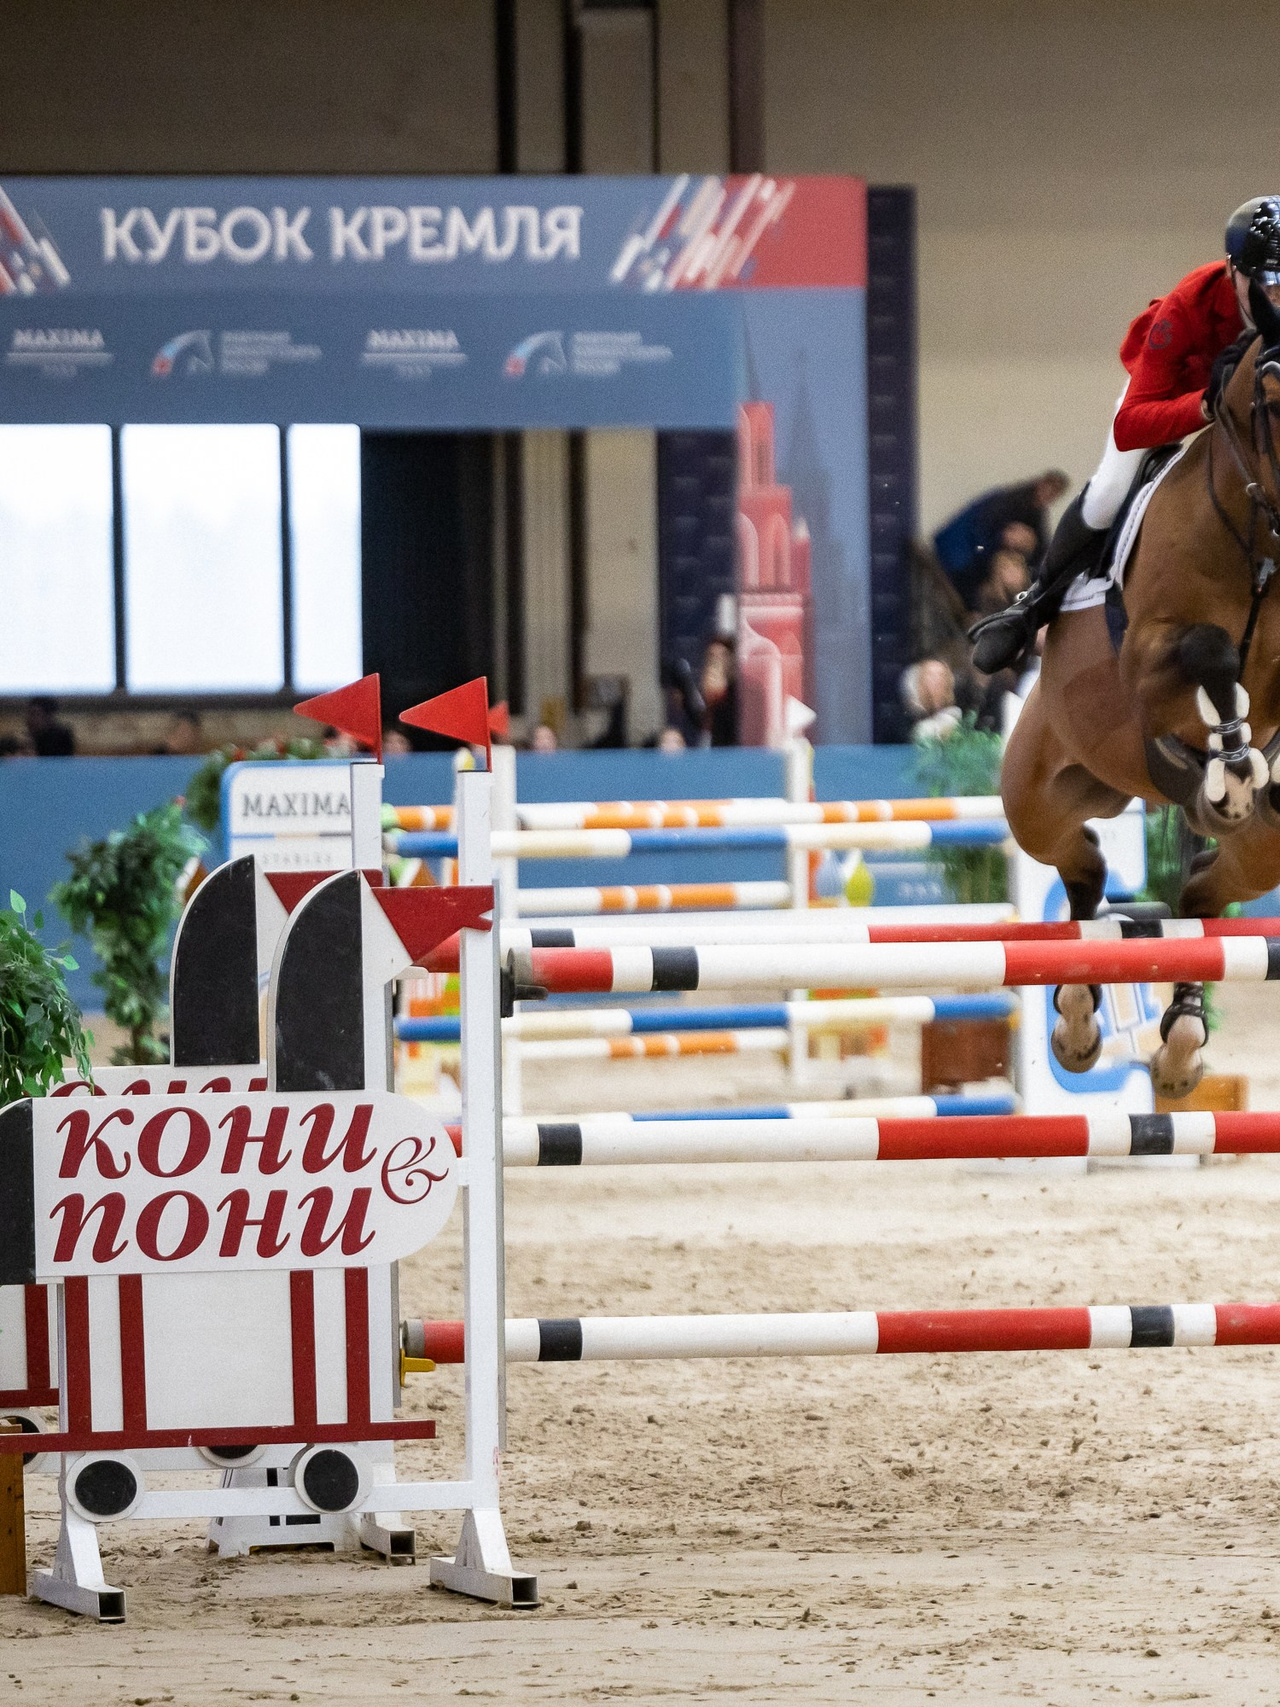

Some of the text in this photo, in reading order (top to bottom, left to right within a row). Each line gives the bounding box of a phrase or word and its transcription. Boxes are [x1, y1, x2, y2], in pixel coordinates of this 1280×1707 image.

[102, 206, 584, 264] КУБОК КРЕМЛЯ
[242, 793, 350, 816] MAXIMA
